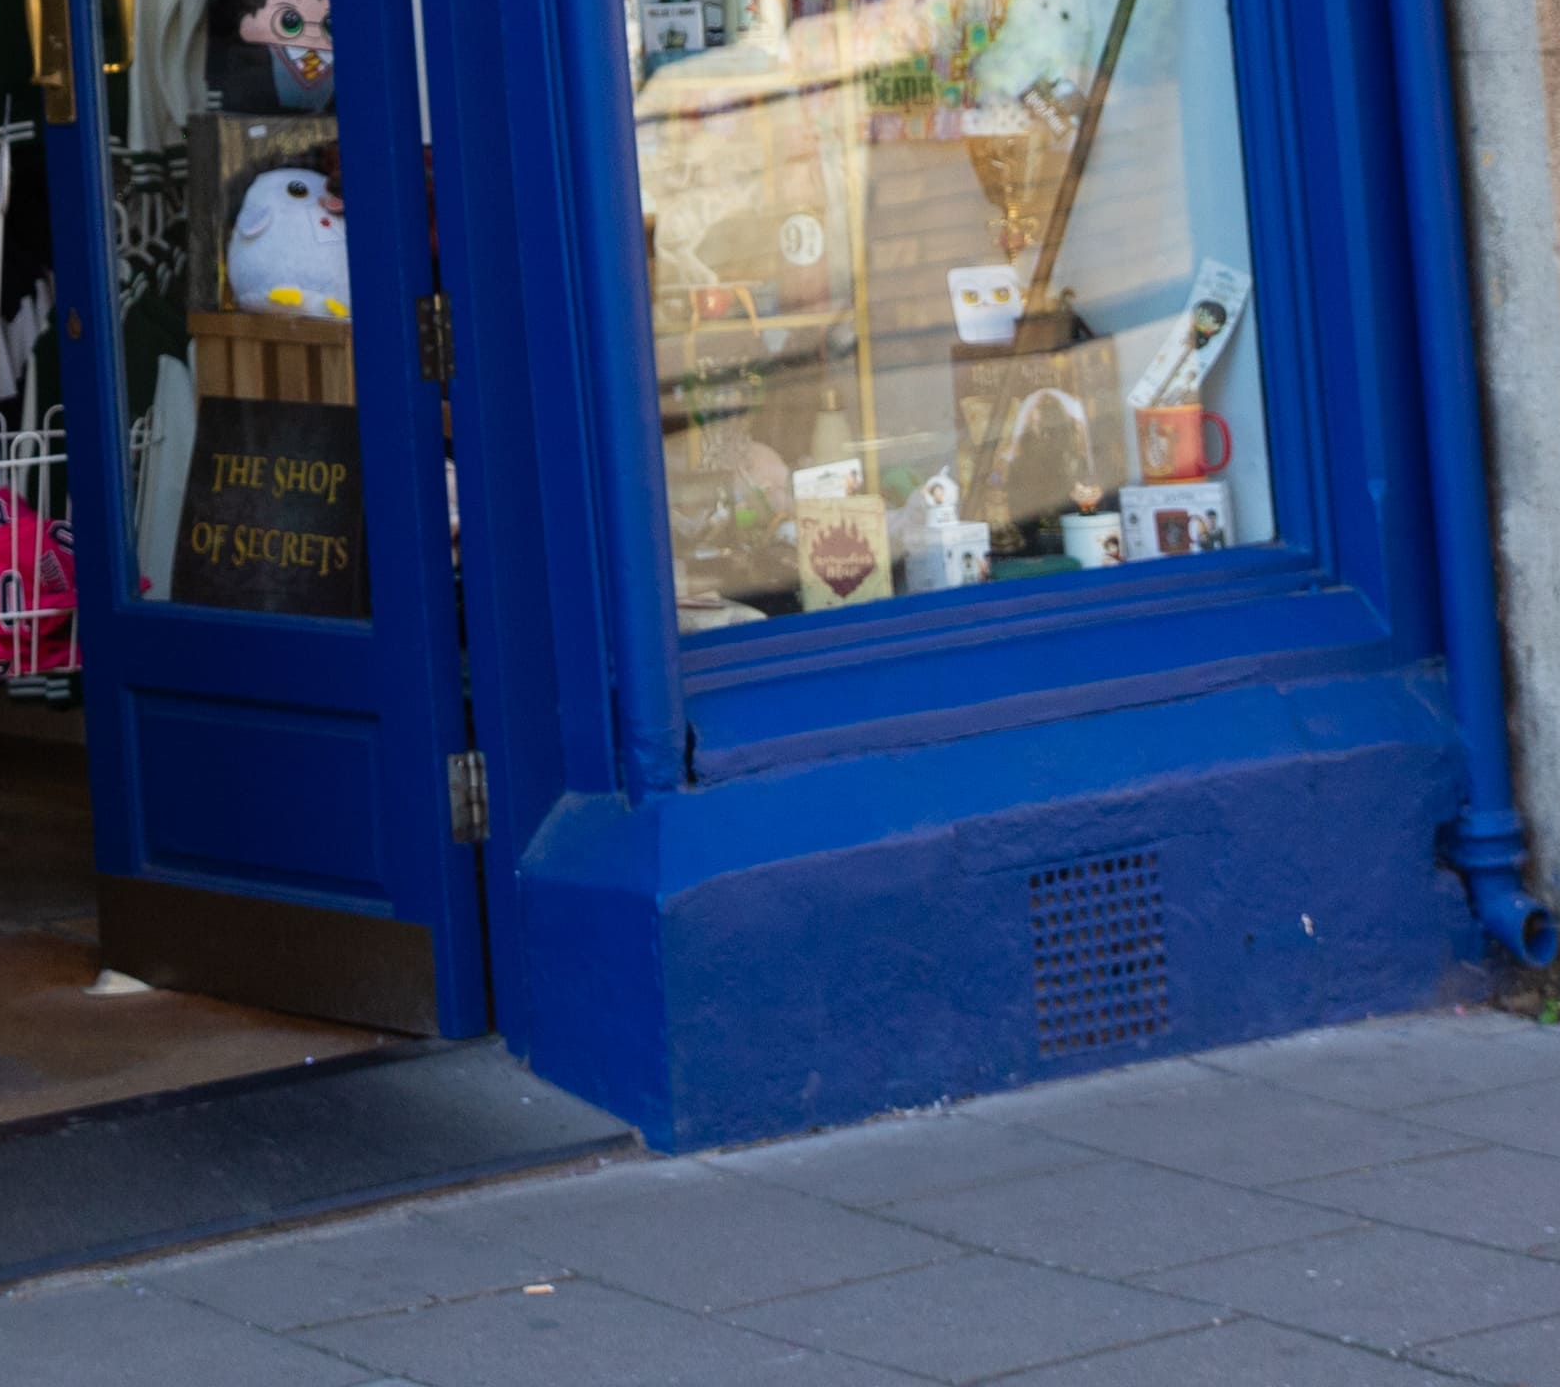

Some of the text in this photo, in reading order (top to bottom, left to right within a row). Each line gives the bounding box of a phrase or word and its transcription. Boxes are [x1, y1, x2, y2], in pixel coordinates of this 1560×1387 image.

[212, 454, 346, 504] THE SHOP
[190, 522, 349, 577] OF SECRETS
